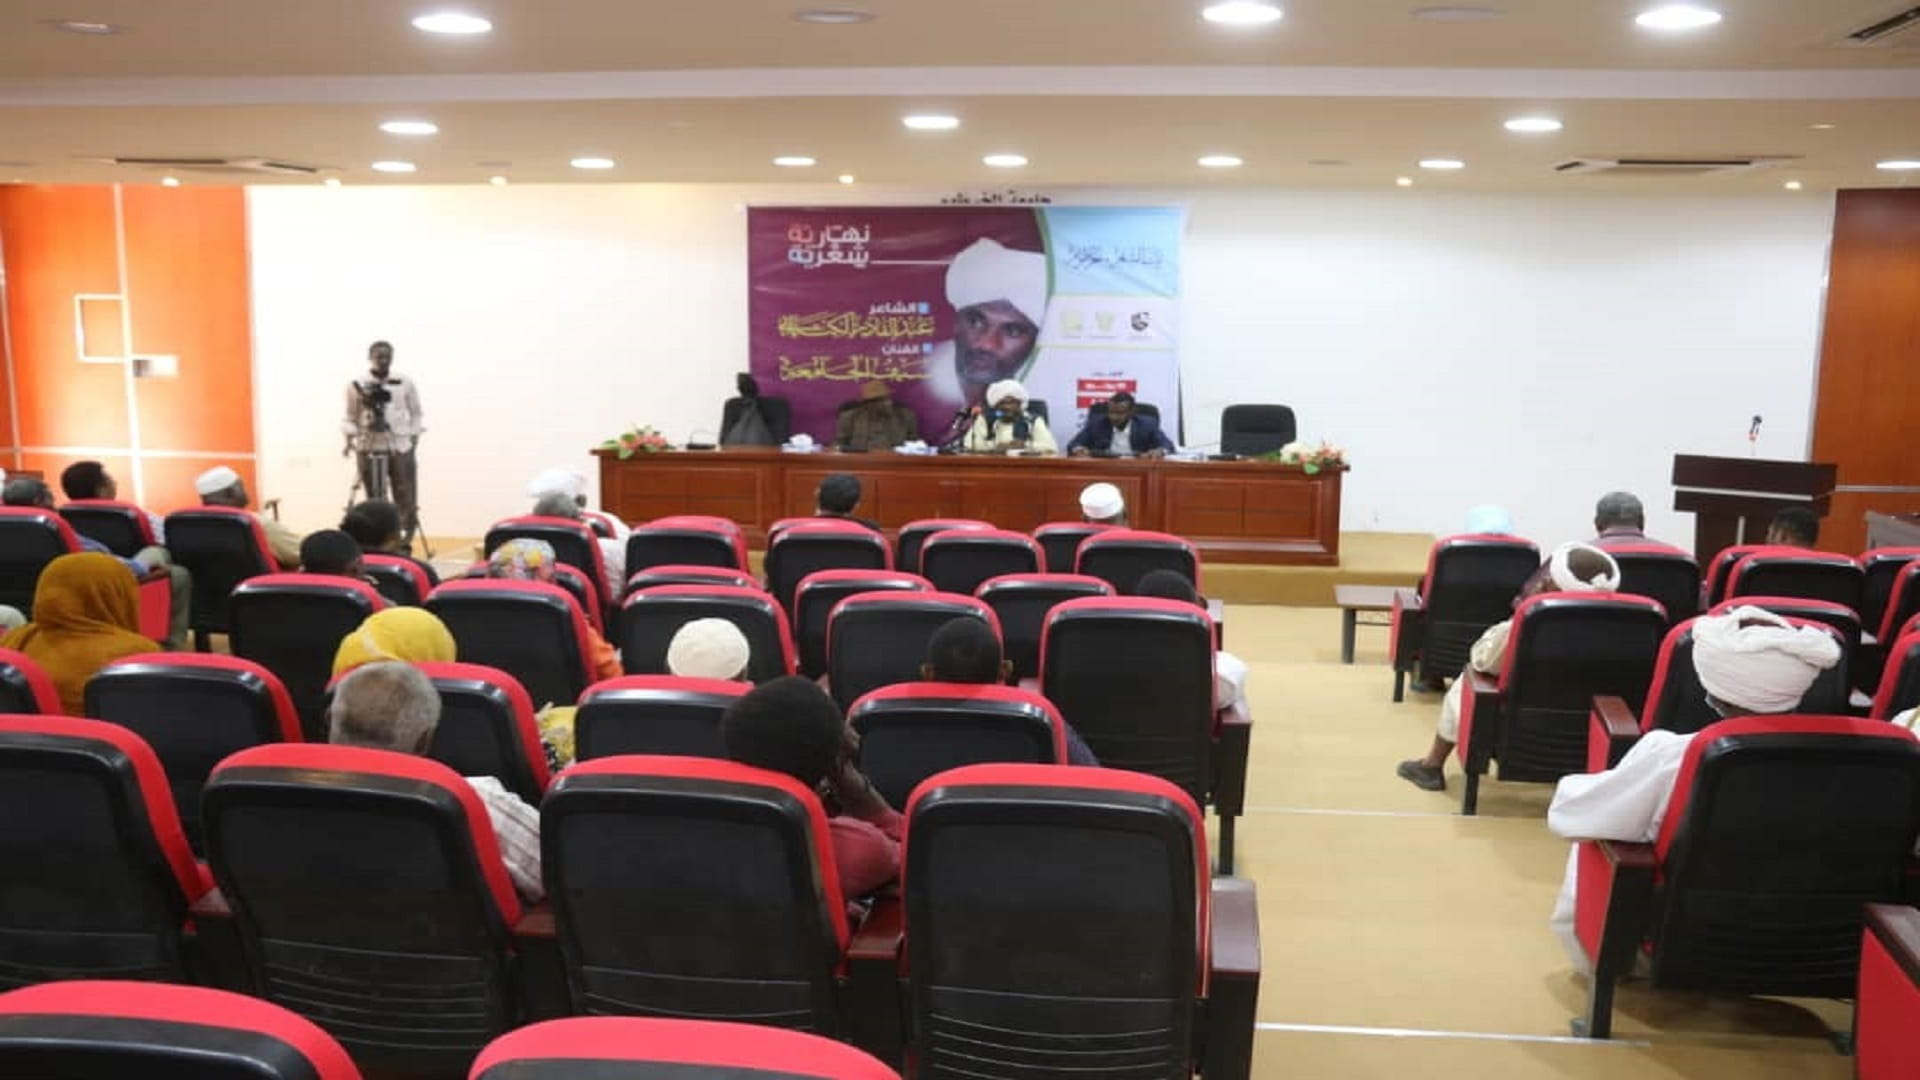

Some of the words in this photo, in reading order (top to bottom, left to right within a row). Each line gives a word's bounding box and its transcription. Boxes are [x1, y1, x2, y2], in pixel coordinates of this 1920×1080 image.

[787, 223, 870, 249] نهارية
[787, 247, 870, 269] شعرية
[869, 302, 916, 315] الشاعر
[881, 344, 919, 355] الفنان
